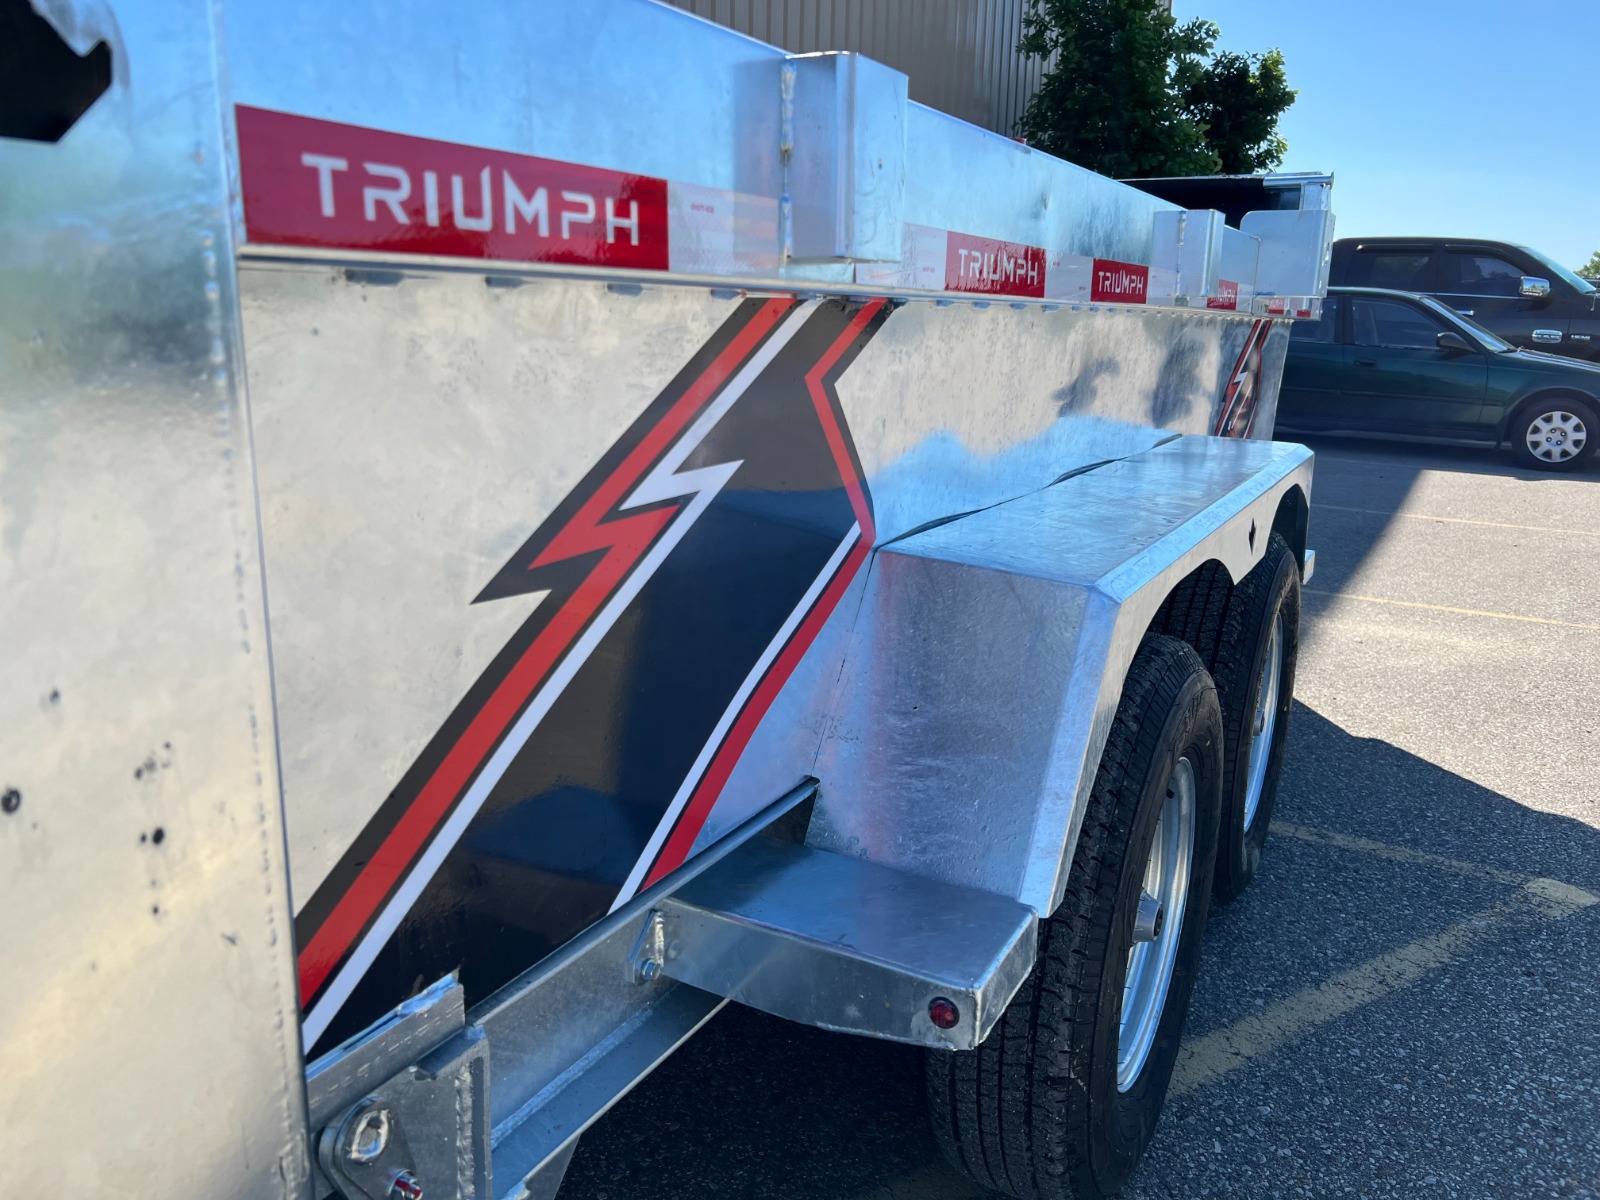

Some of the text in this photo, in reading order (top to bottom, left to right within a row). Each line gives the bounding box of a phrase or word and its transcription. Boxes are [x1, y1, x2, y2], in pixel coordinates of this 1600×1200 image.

[301, 152, 639, 246] TRIUMPH
[958, 248, 1038, 286] TRIUMPH
[1098, 269, 1144, 295] TRIUMPH
